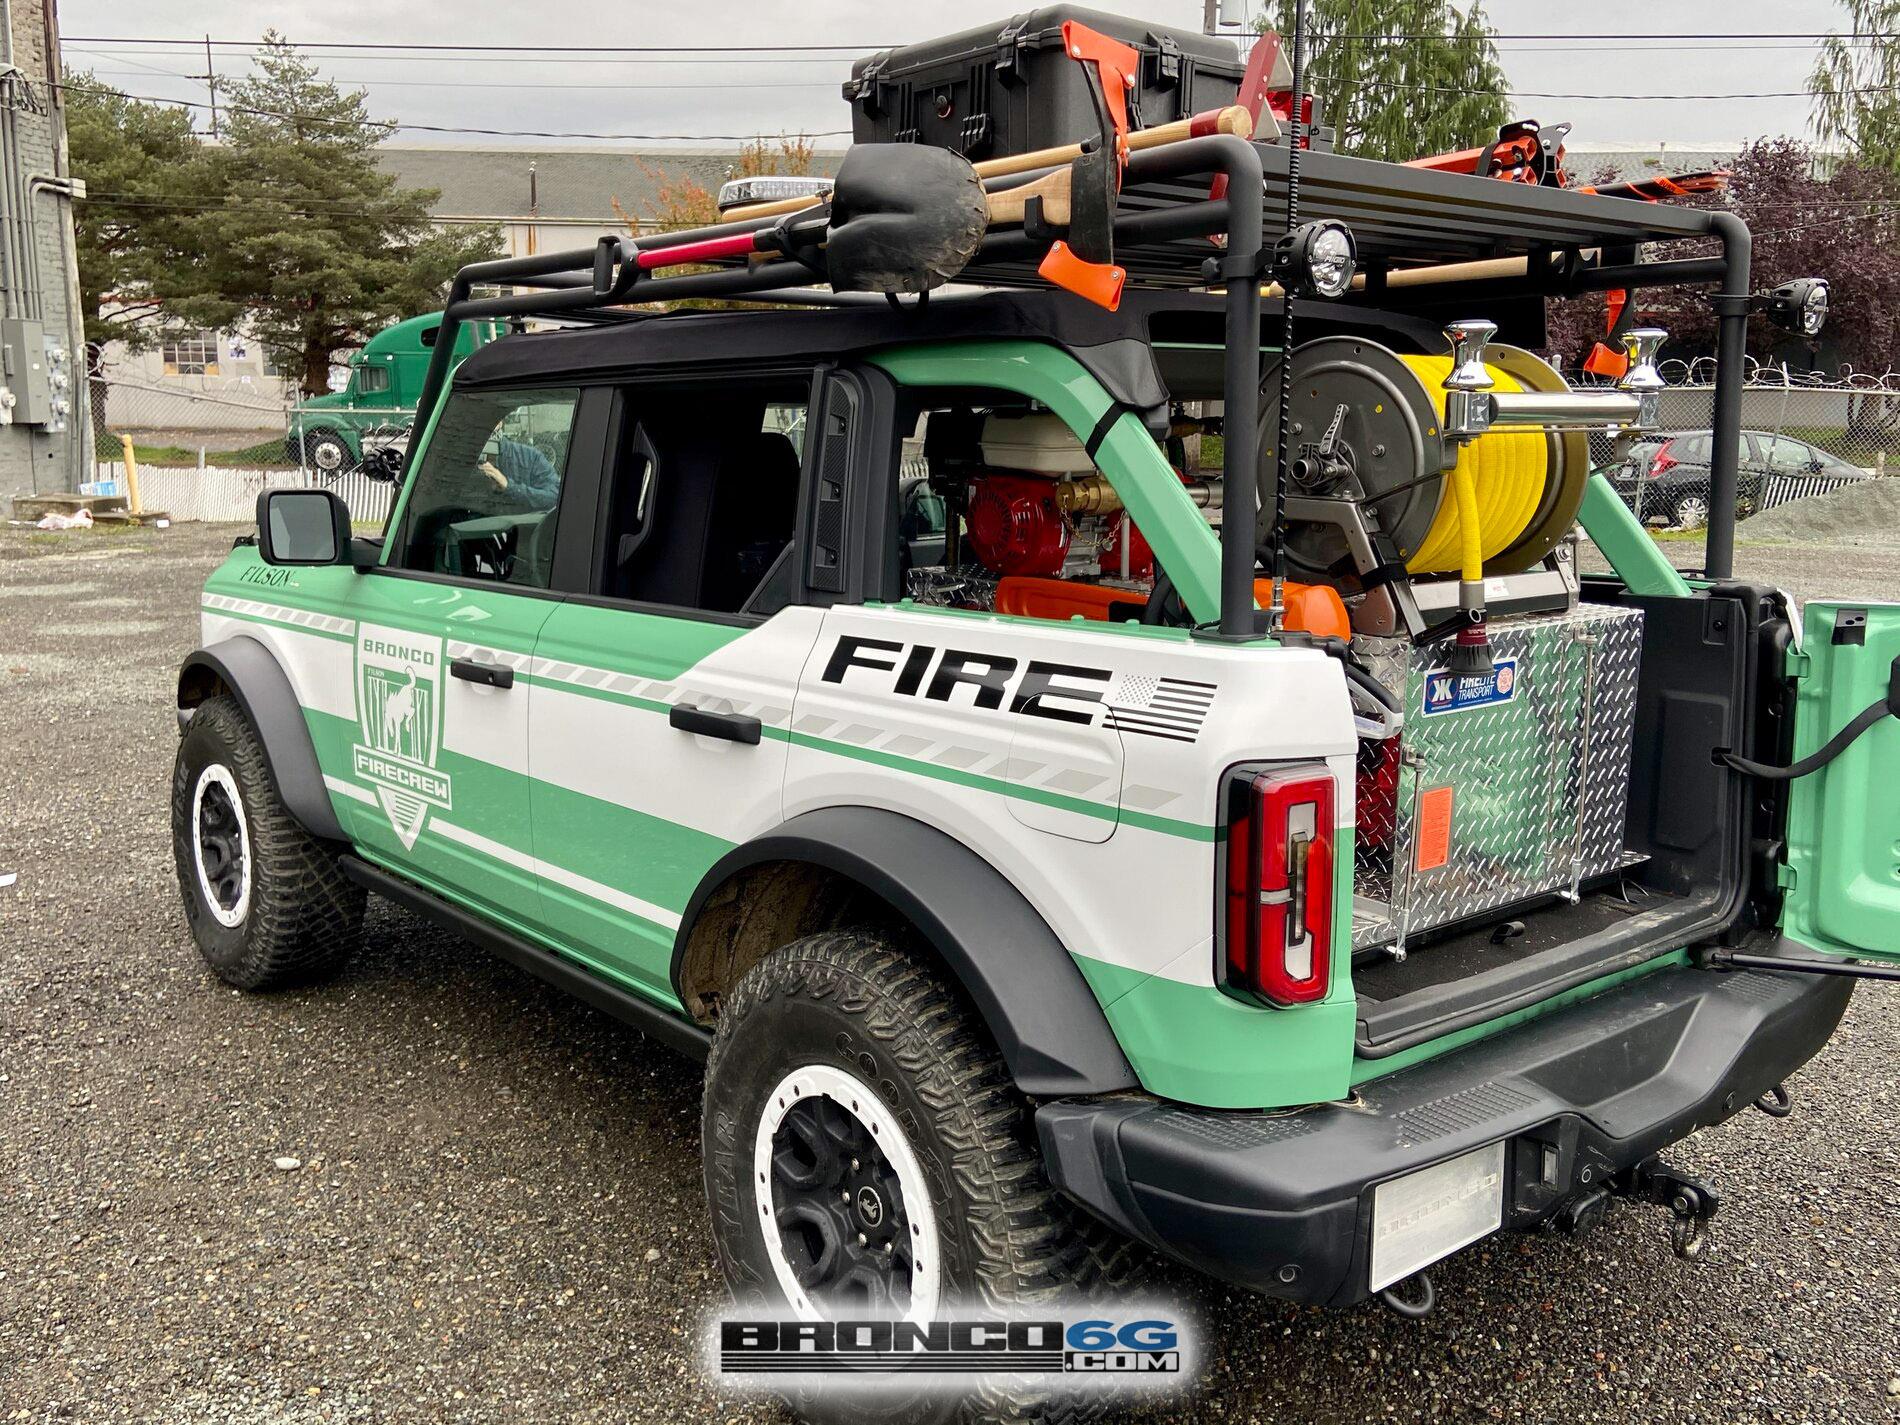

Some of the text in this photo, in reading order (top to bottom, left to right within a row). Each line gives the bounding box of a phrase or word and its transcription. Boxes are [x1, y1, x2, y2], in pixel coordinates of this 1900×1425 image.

[240, 566, 296, 587] FILSON
[364, 639, 434, 665] BRONCO
[821, 635, 1113, 725] FIRE
[1458, 685, 1494, 700] TRANSPORT
[357, 754, 447, 798] FIRECREW
